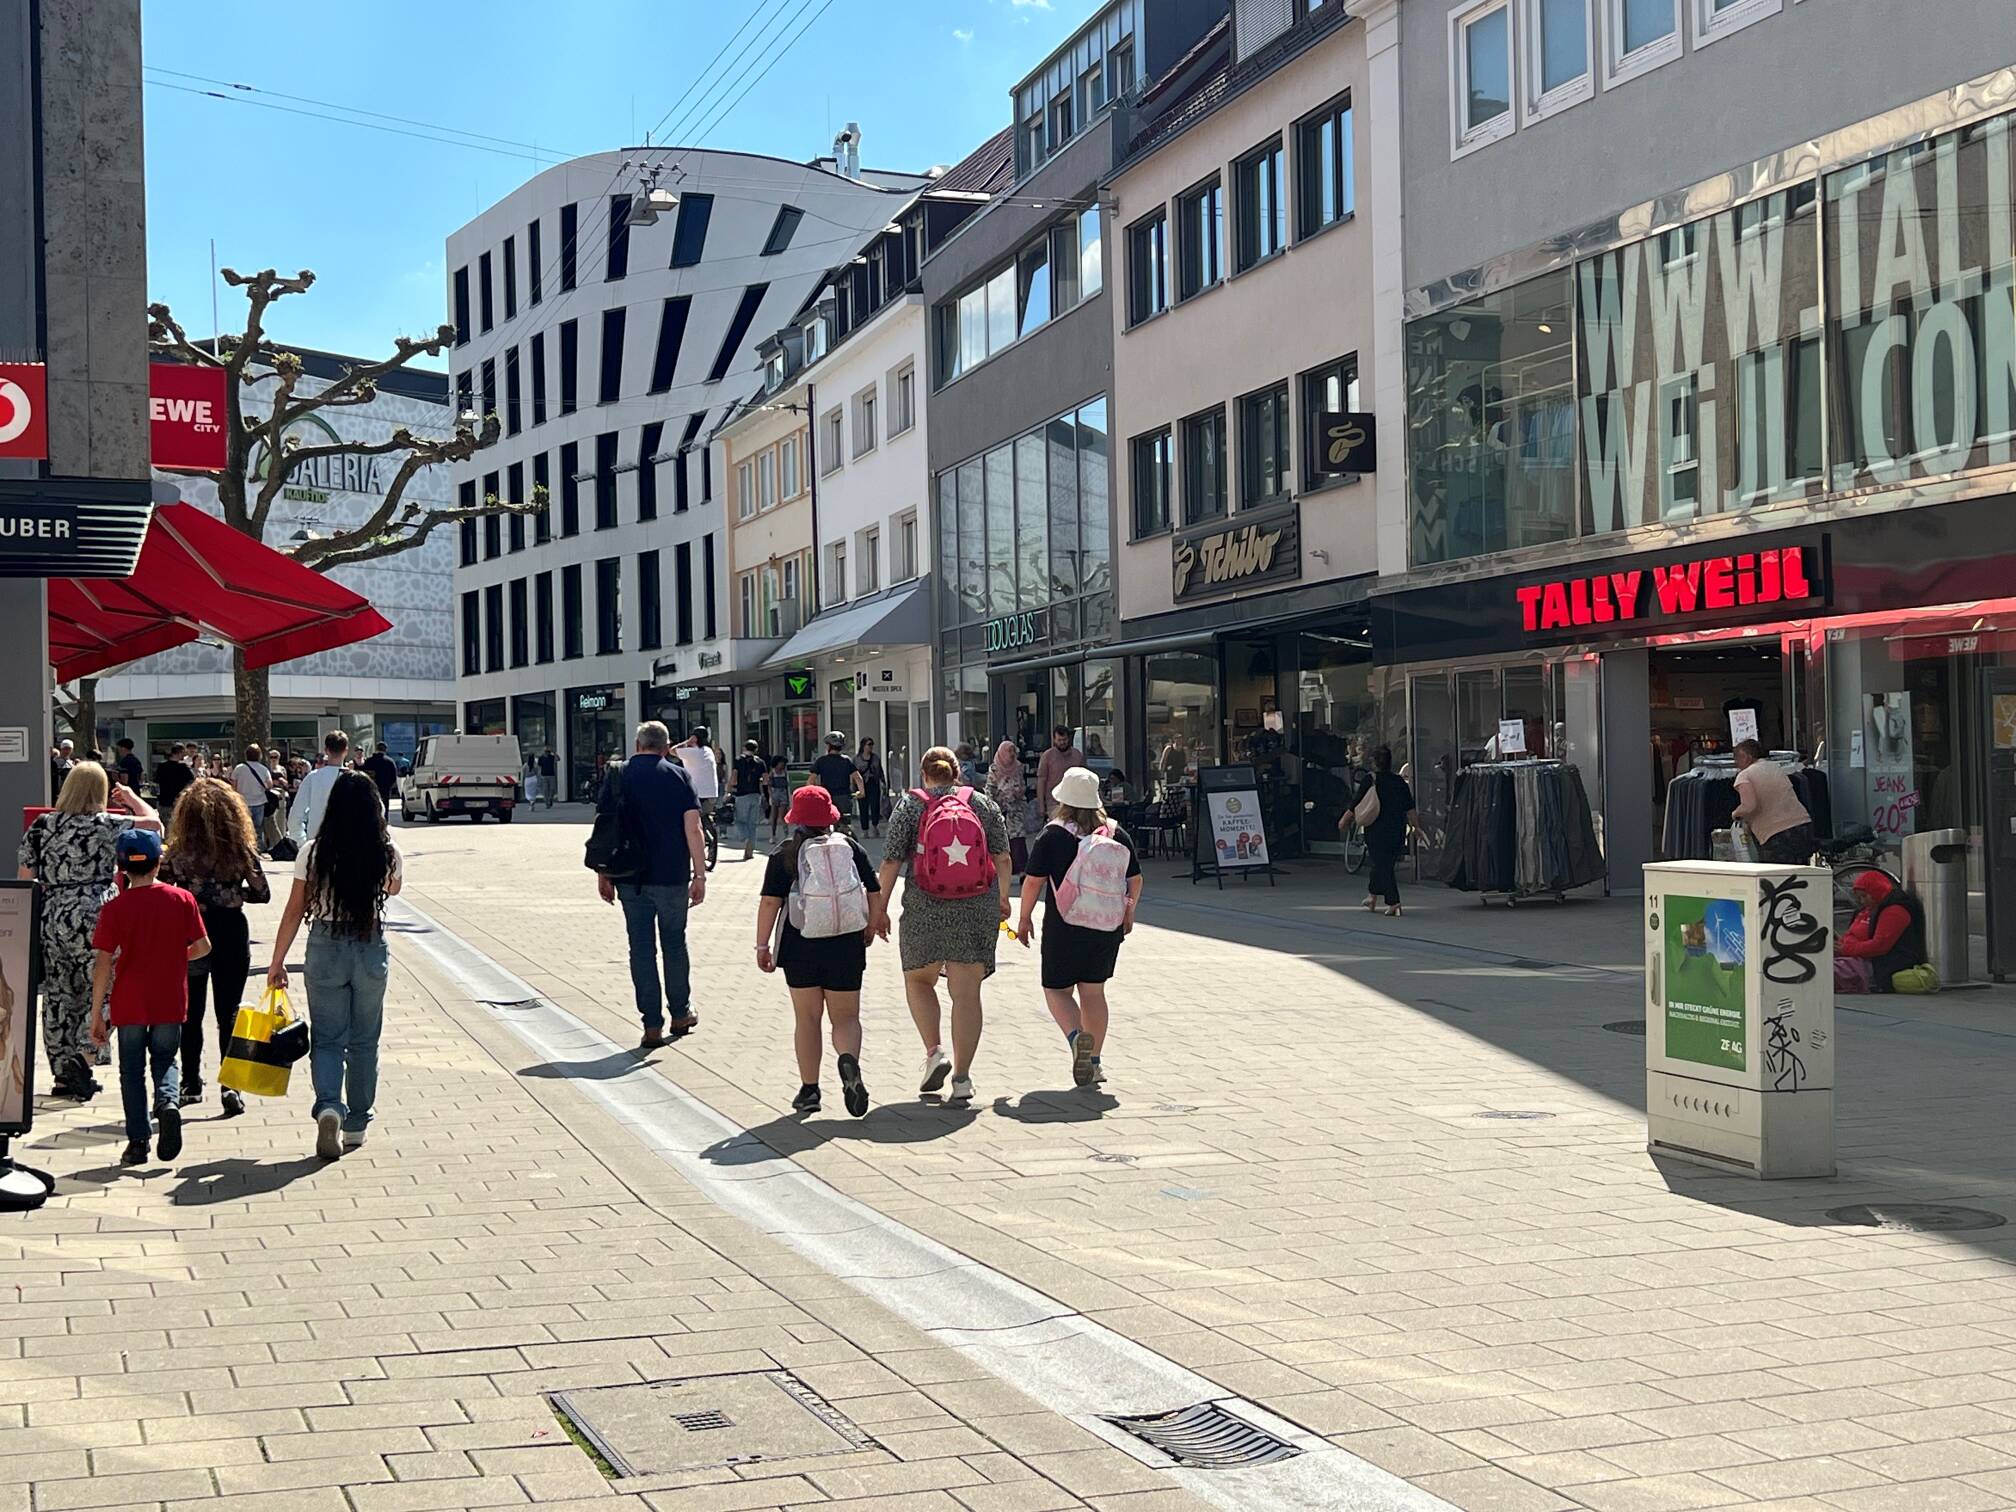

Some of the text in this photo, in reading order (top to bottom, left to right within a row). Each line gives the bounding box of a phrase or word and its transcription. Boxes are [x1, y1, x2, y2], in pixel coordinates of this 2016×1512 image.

[149, 397, 213, 424] EWE
[193, 424, 221, 433] CITY
[0, 517, 70, 538] UBER
[1200, 525, 1281, 585] Tchibo
[1516, 570, 1642, 631] TALLY
[985, 612, 1034, 651] DOUGLAS
[1874, 775, 1906, 793] JEANS
[1649, 895, 1658, 908] 11
